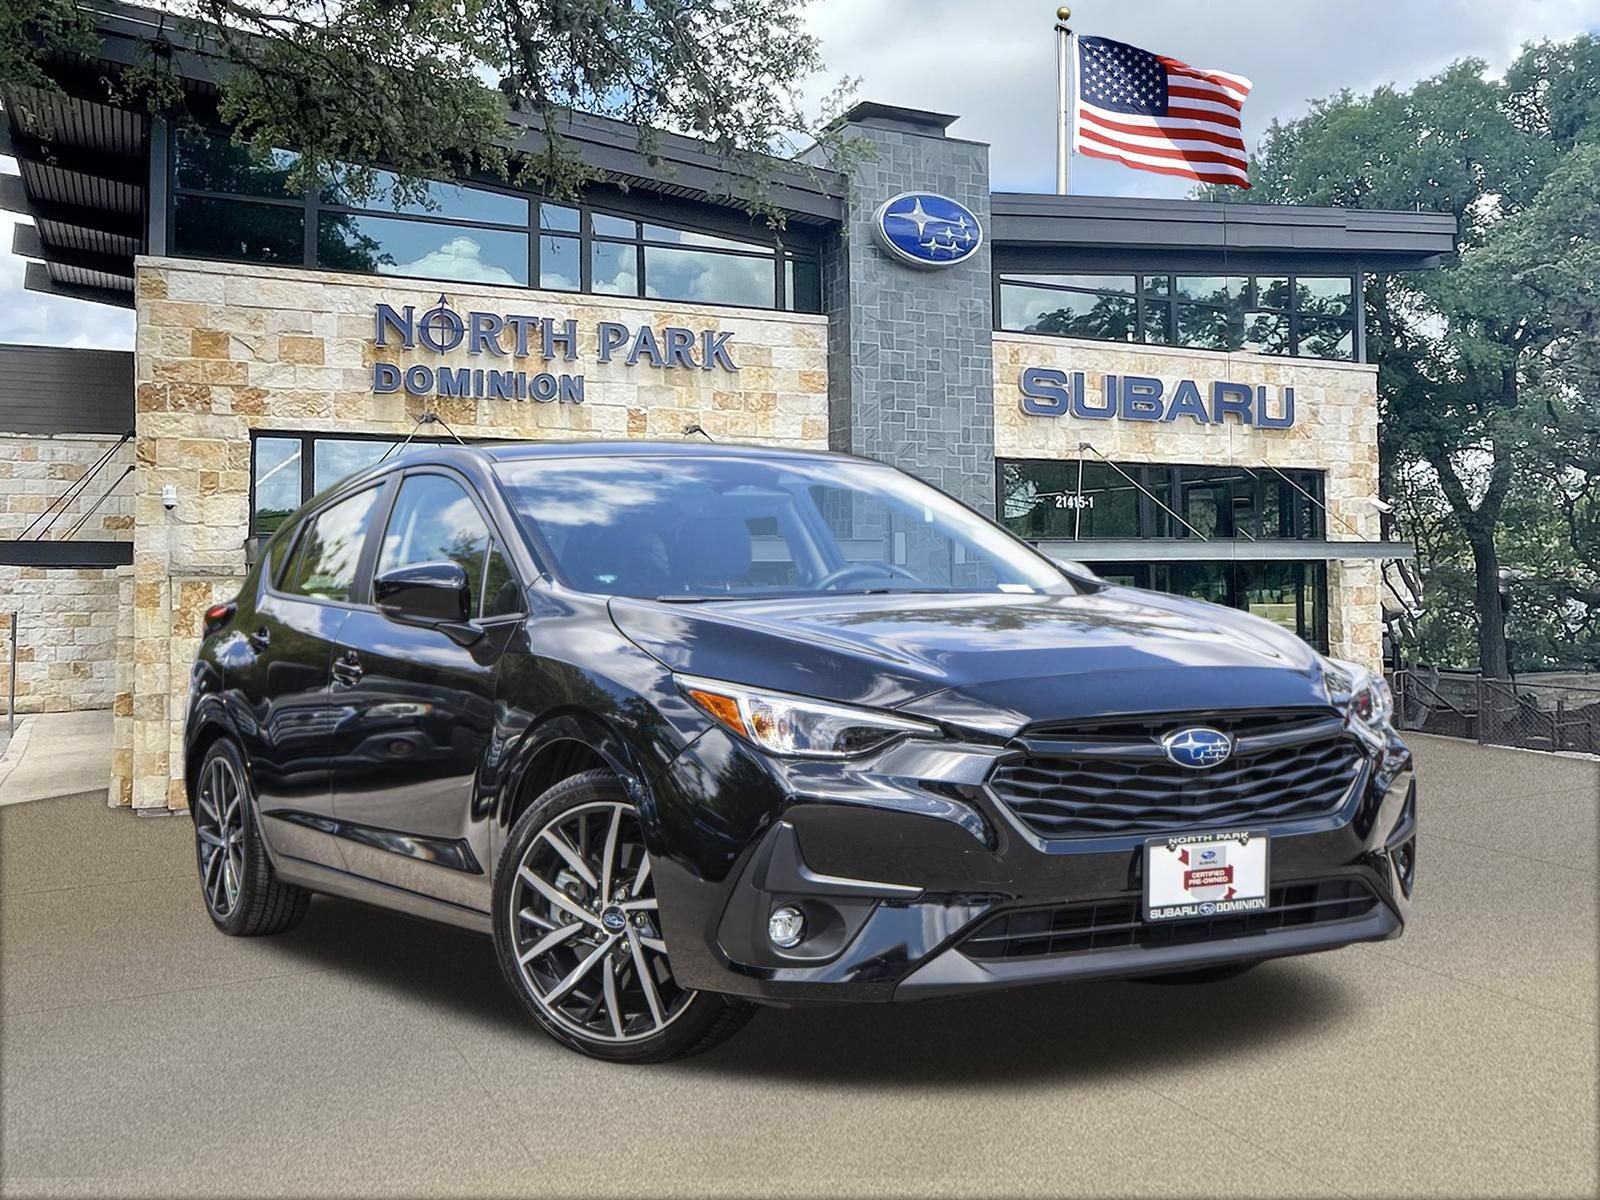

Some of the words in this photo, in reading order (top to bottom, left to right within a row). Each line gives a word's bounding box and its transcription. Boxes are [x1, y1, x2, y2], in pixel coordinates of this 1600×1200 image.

[375, 297, 579, 362] NORTH
[597, 322, 741, 372] PARK
[373, 362, 585, 404] DOMINION
[1019, 367, 1295, 430] SUBARU
[1168, 835, 1212, 845] NORTH
[1216, 832, 1249, 841] PARK
[1188, 876, 1229, 886] PRE-OWNED
[1191, 870, 1225, 879] CERTIFIED
[1150, 905, 1198, 919] SUBARU
[1216, 898, 1266, 912] DOMINION
